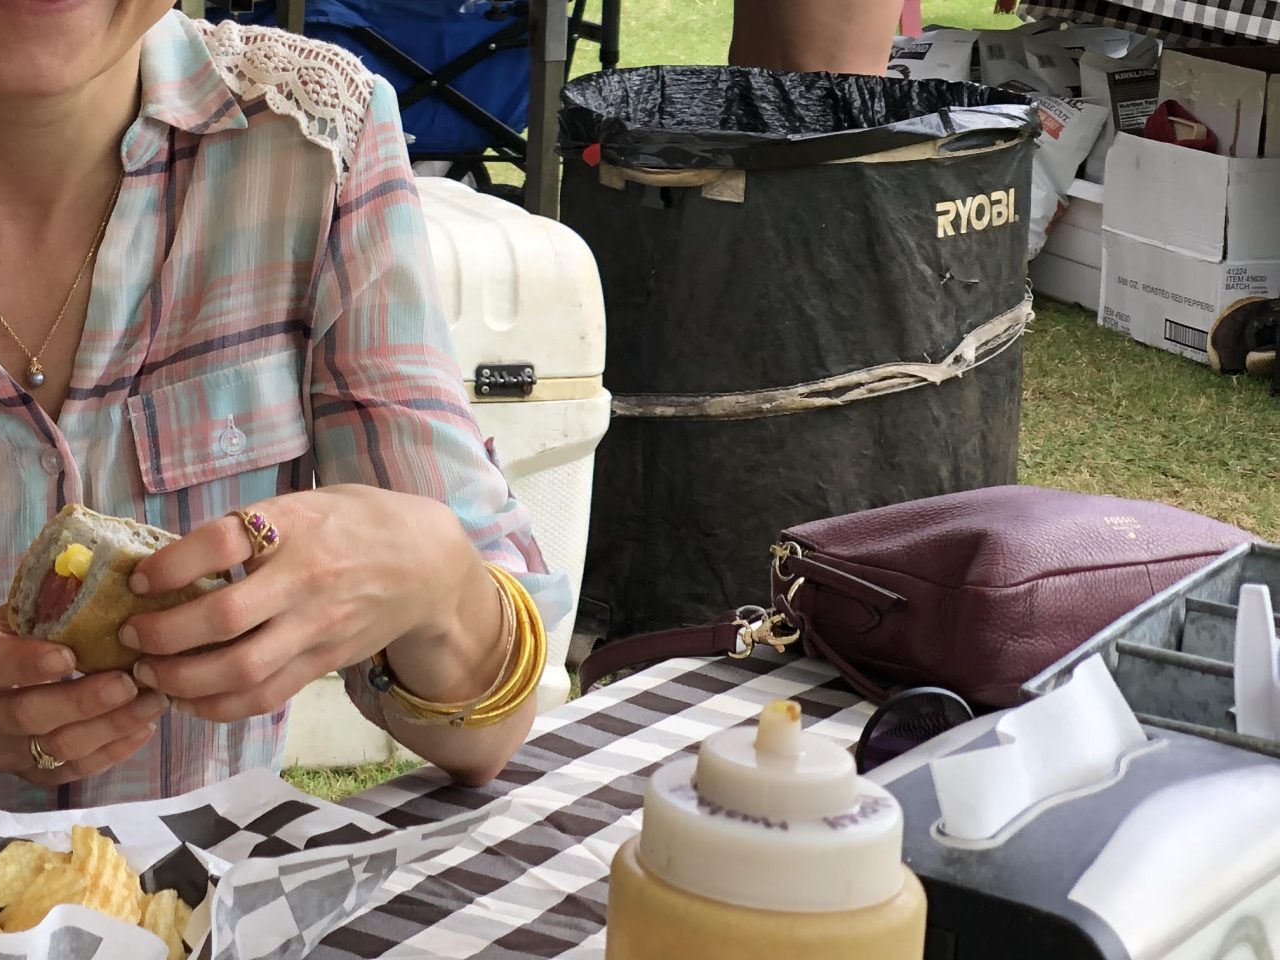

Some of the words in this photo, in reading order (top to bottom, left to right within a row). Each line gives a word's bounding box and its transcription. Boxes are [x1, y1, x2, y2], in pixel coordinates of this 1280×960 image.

[935, 187, 1015, 238] RYOBI
[1142, 283, 1170, 299] ROASTED
[1170, 292, 1183, 304] RED
[1183, 296, 1215, 313] PEPPERS
